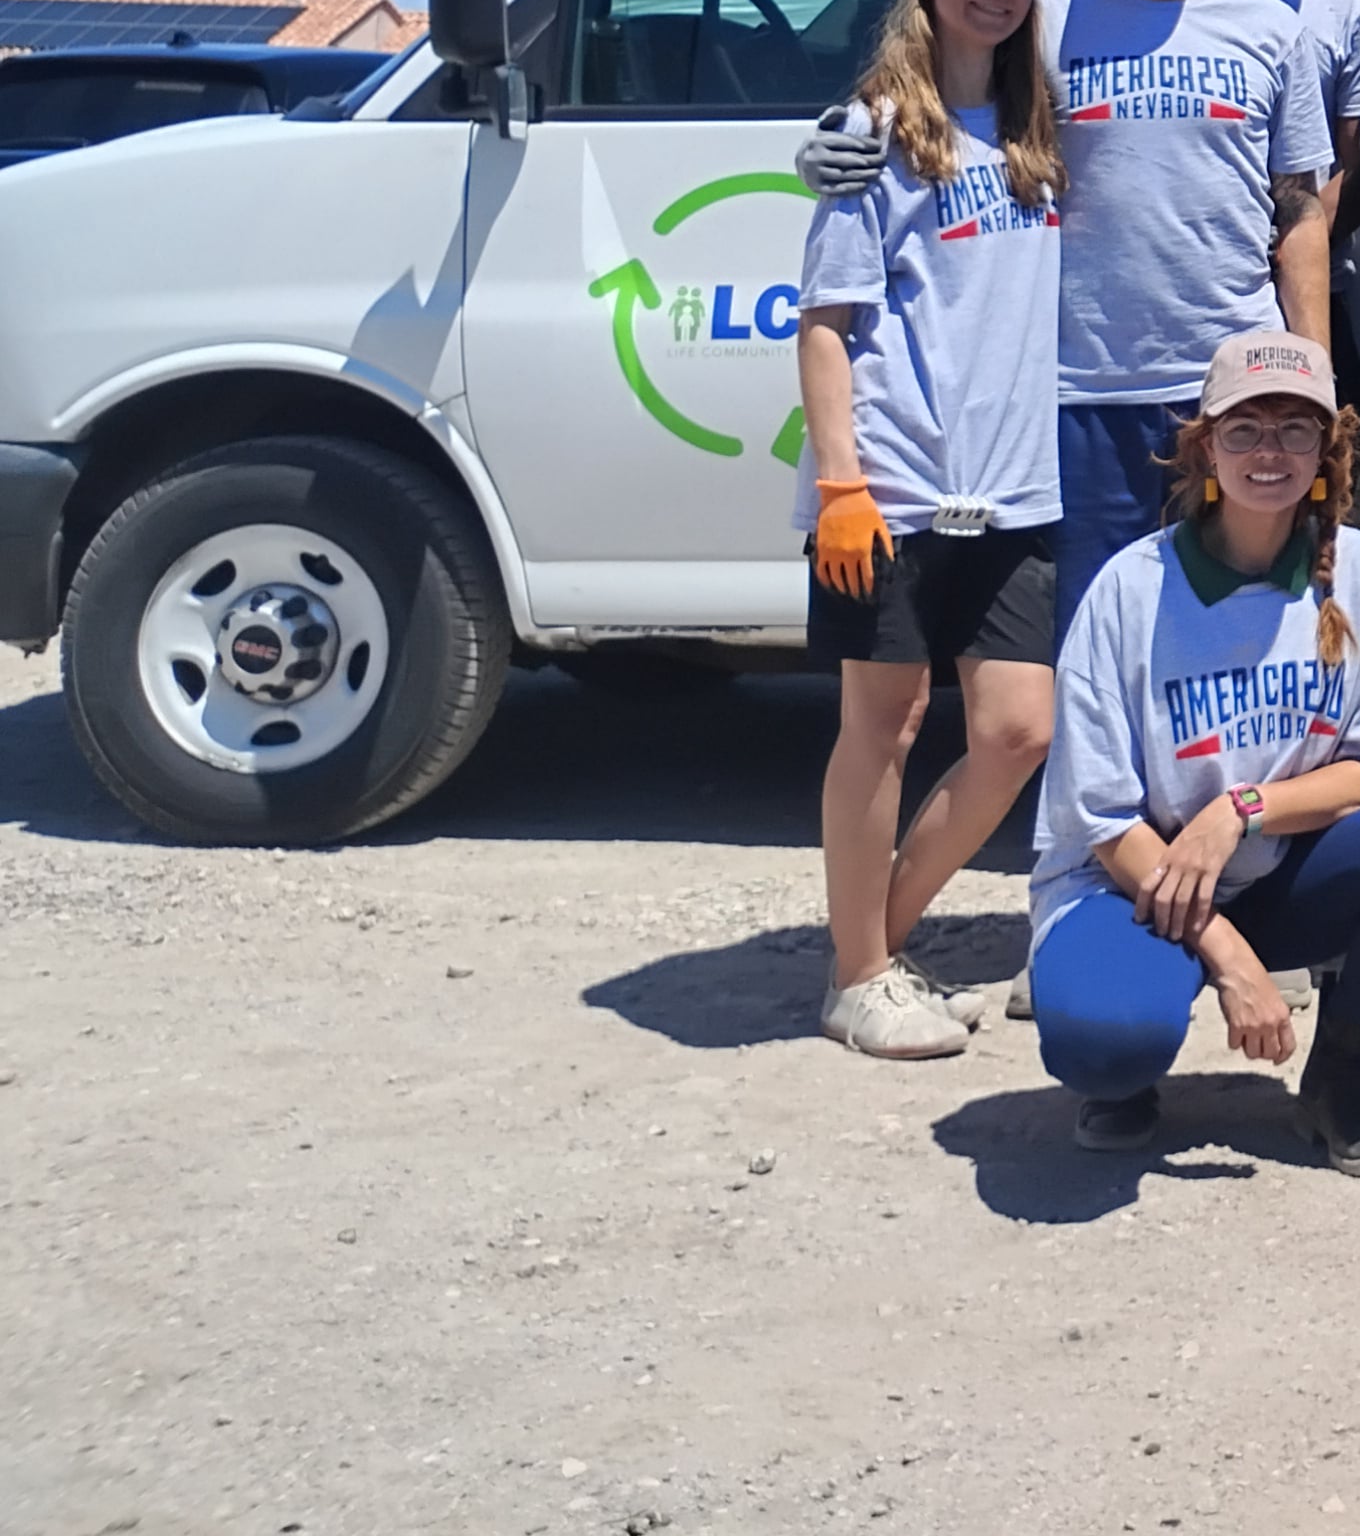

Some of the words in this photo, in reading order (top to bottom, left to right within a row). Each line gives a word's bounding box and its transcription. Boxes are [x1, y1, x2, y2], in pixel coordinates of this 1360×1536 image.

[1069, 55, 1248, 109] AMERICA250
[1116, 93, 1205, 120] NEVADA
[667, 346, 696, 358] LIFE
[701, 346, 793, 359] COMMUNITY
[233, 639, 281, 661] GMC
[1225, 713, 1307, 752] NEVADA
